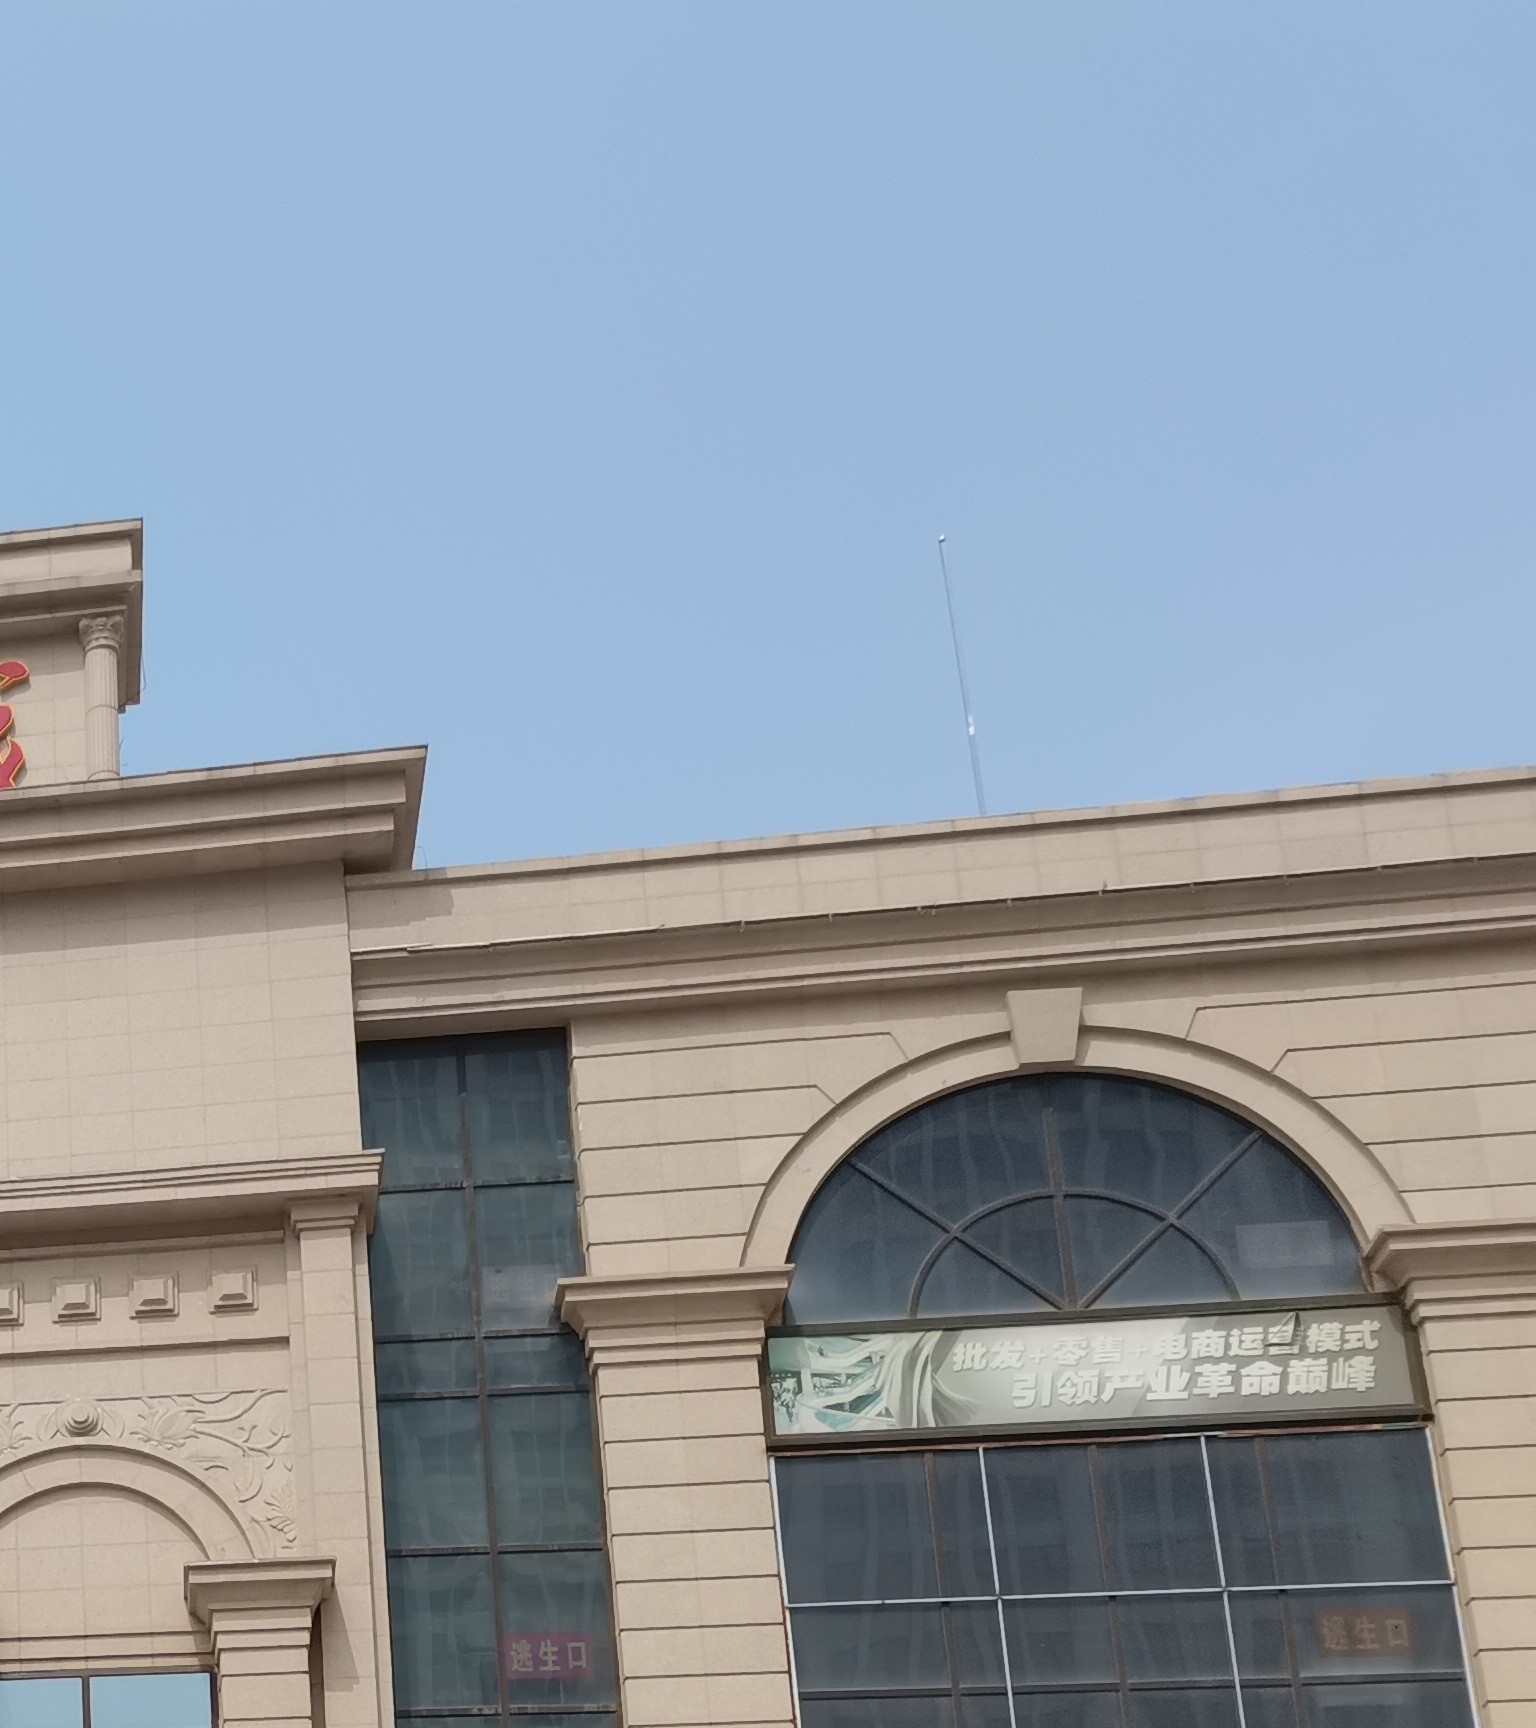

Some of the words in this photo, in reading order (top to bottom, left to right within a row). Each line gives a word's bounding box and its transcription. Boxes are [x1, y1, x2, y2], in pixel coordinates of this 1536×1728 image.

[1011, 1357, 1377, 1408] 引领产业革命巅峰
[1322, 1616, 1408, 1650] 逃生口
[508, 1638, 588, 1675] 逃生口
